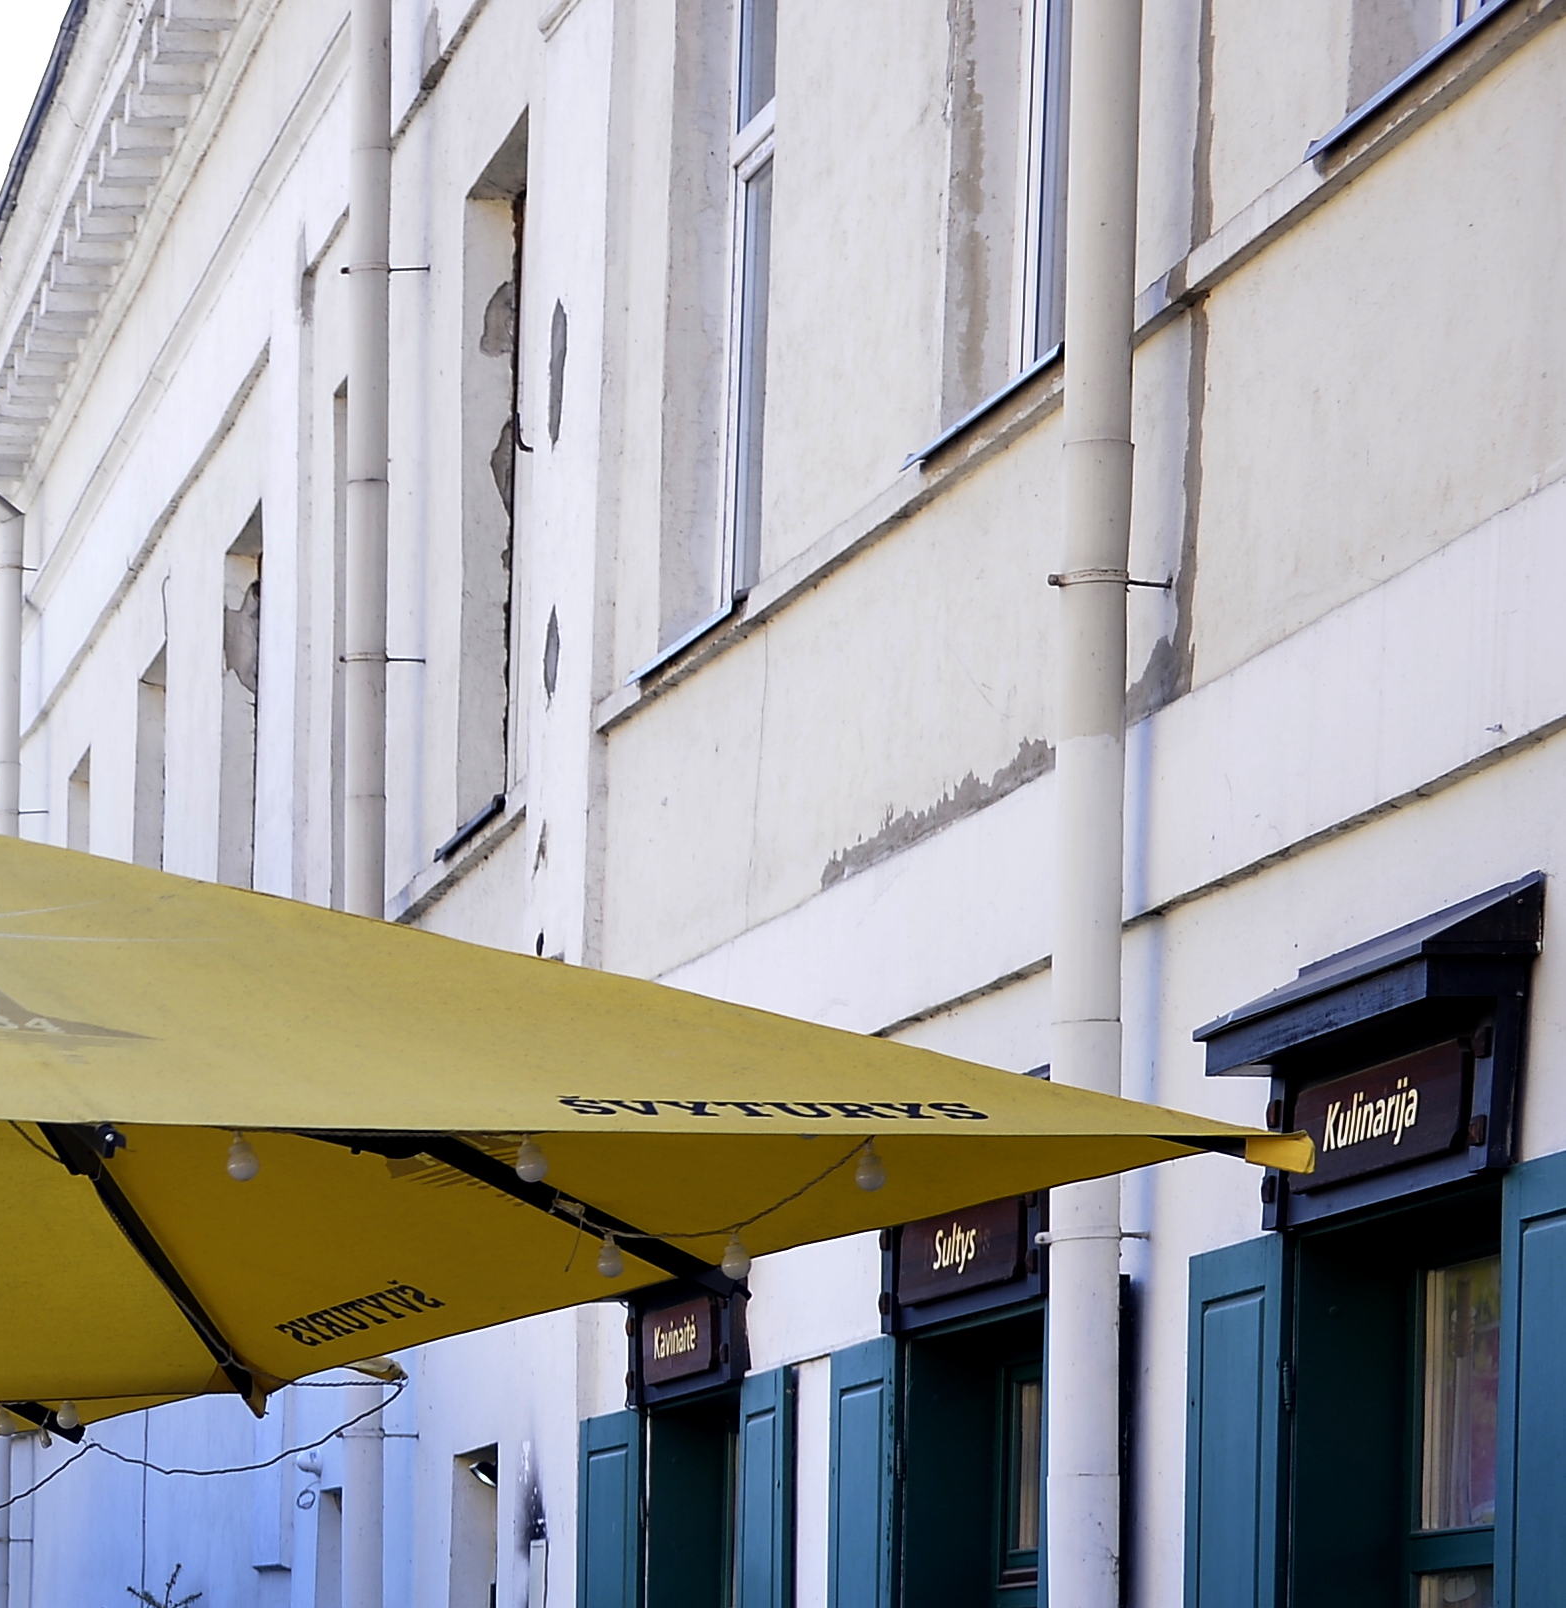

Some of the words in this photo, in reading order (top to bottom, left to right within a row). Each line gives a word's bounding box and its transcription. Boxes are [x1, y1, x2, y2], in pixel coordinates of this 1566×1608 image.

[557, 1095, 990, 1121] ŠVYTURYS
[1322, 1076, 1418, 1152] Kulinarija
[933, 1222, 977, 1274] Sultys
